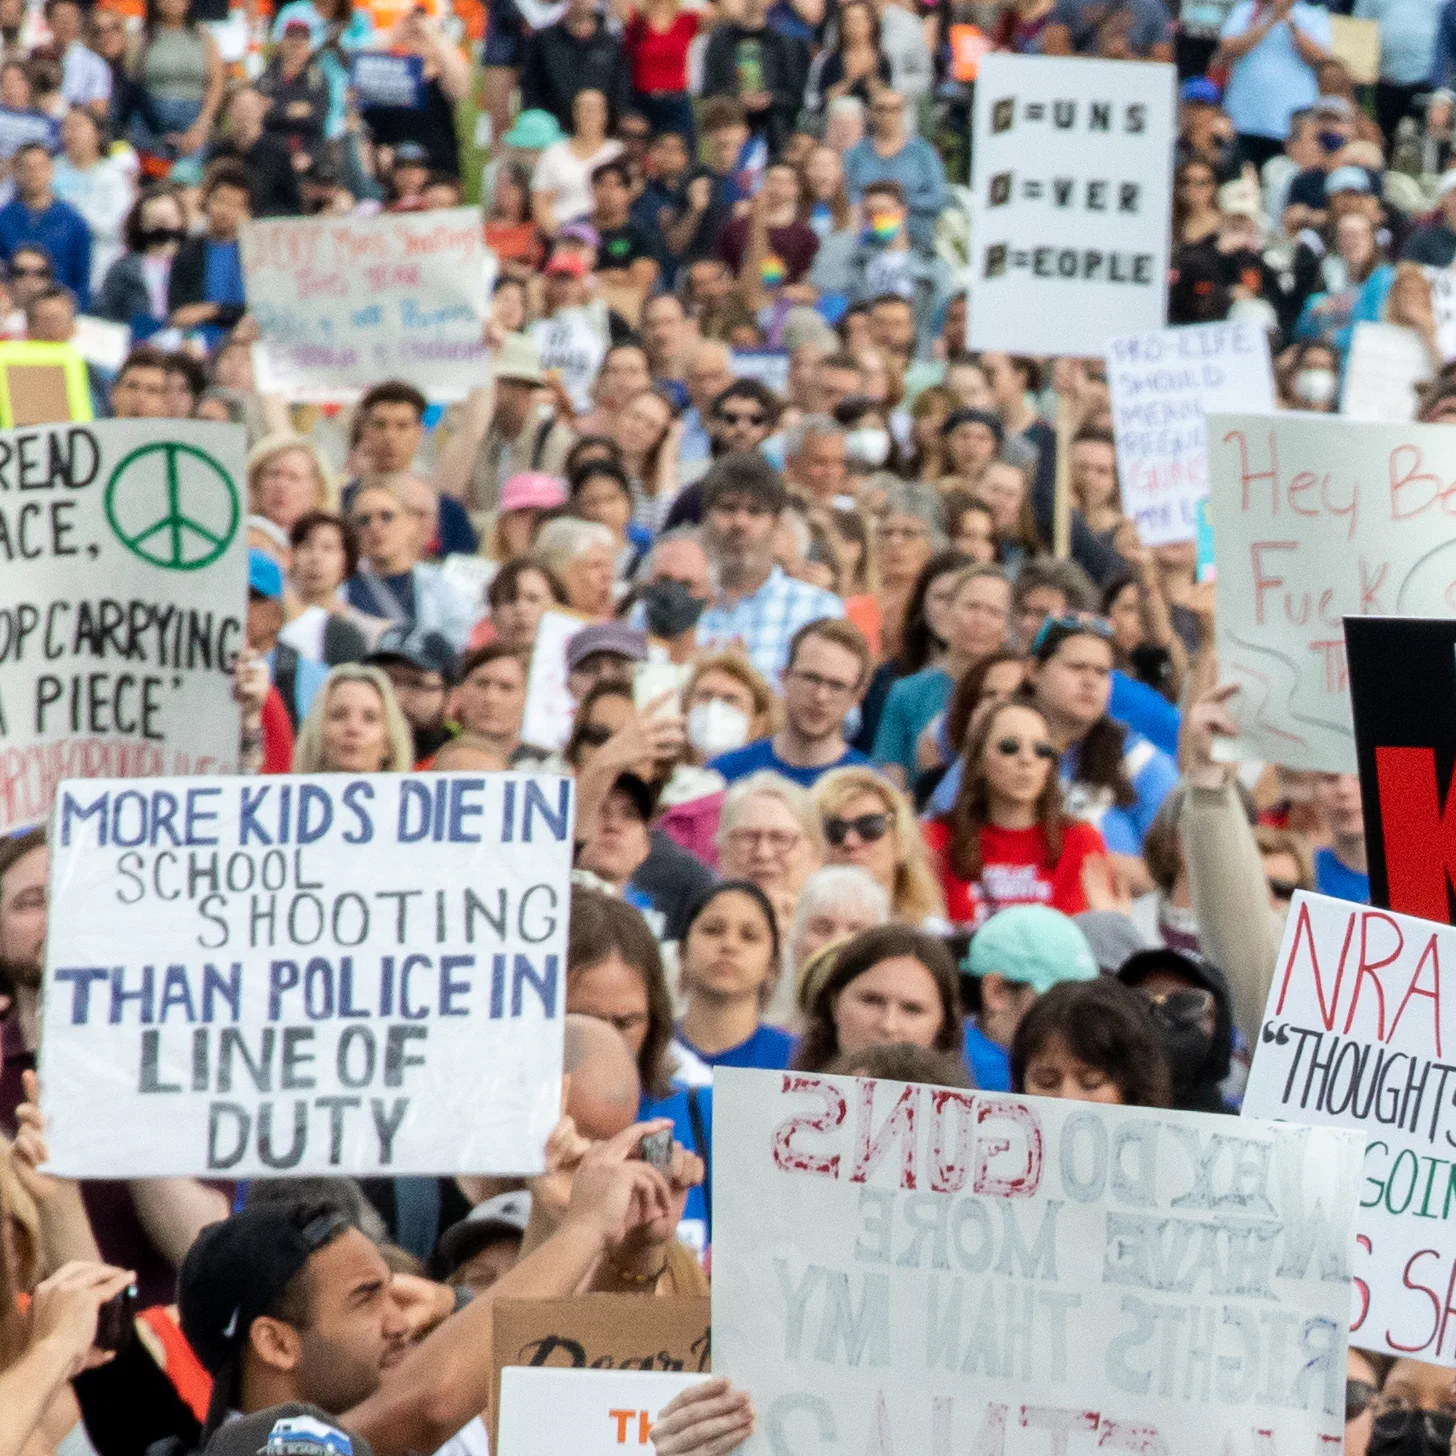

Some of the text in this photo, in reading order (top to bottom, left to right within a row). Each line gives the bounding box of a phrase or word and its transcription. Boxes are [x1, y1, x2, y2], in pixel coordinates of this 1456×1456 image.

[1223, 429, 1358, 538] Hey
[59, 786, 223, 848] MORE
[239, 780, 377, 847] KIDS
[398, 777, 501, 845] DIE
[501, 778, 571, 844] IN
[115, 847, 325, 905] SCHOOL
[197, 881, 559, 950] SHOOTING
[53, 952, 561, 1027] THAN POLICE IN
[1274, 900, 1444, 1059] NRA
[137, 1024, 429, 1096] LINE OF
[205, 1096, 411, 1170] DUTY
